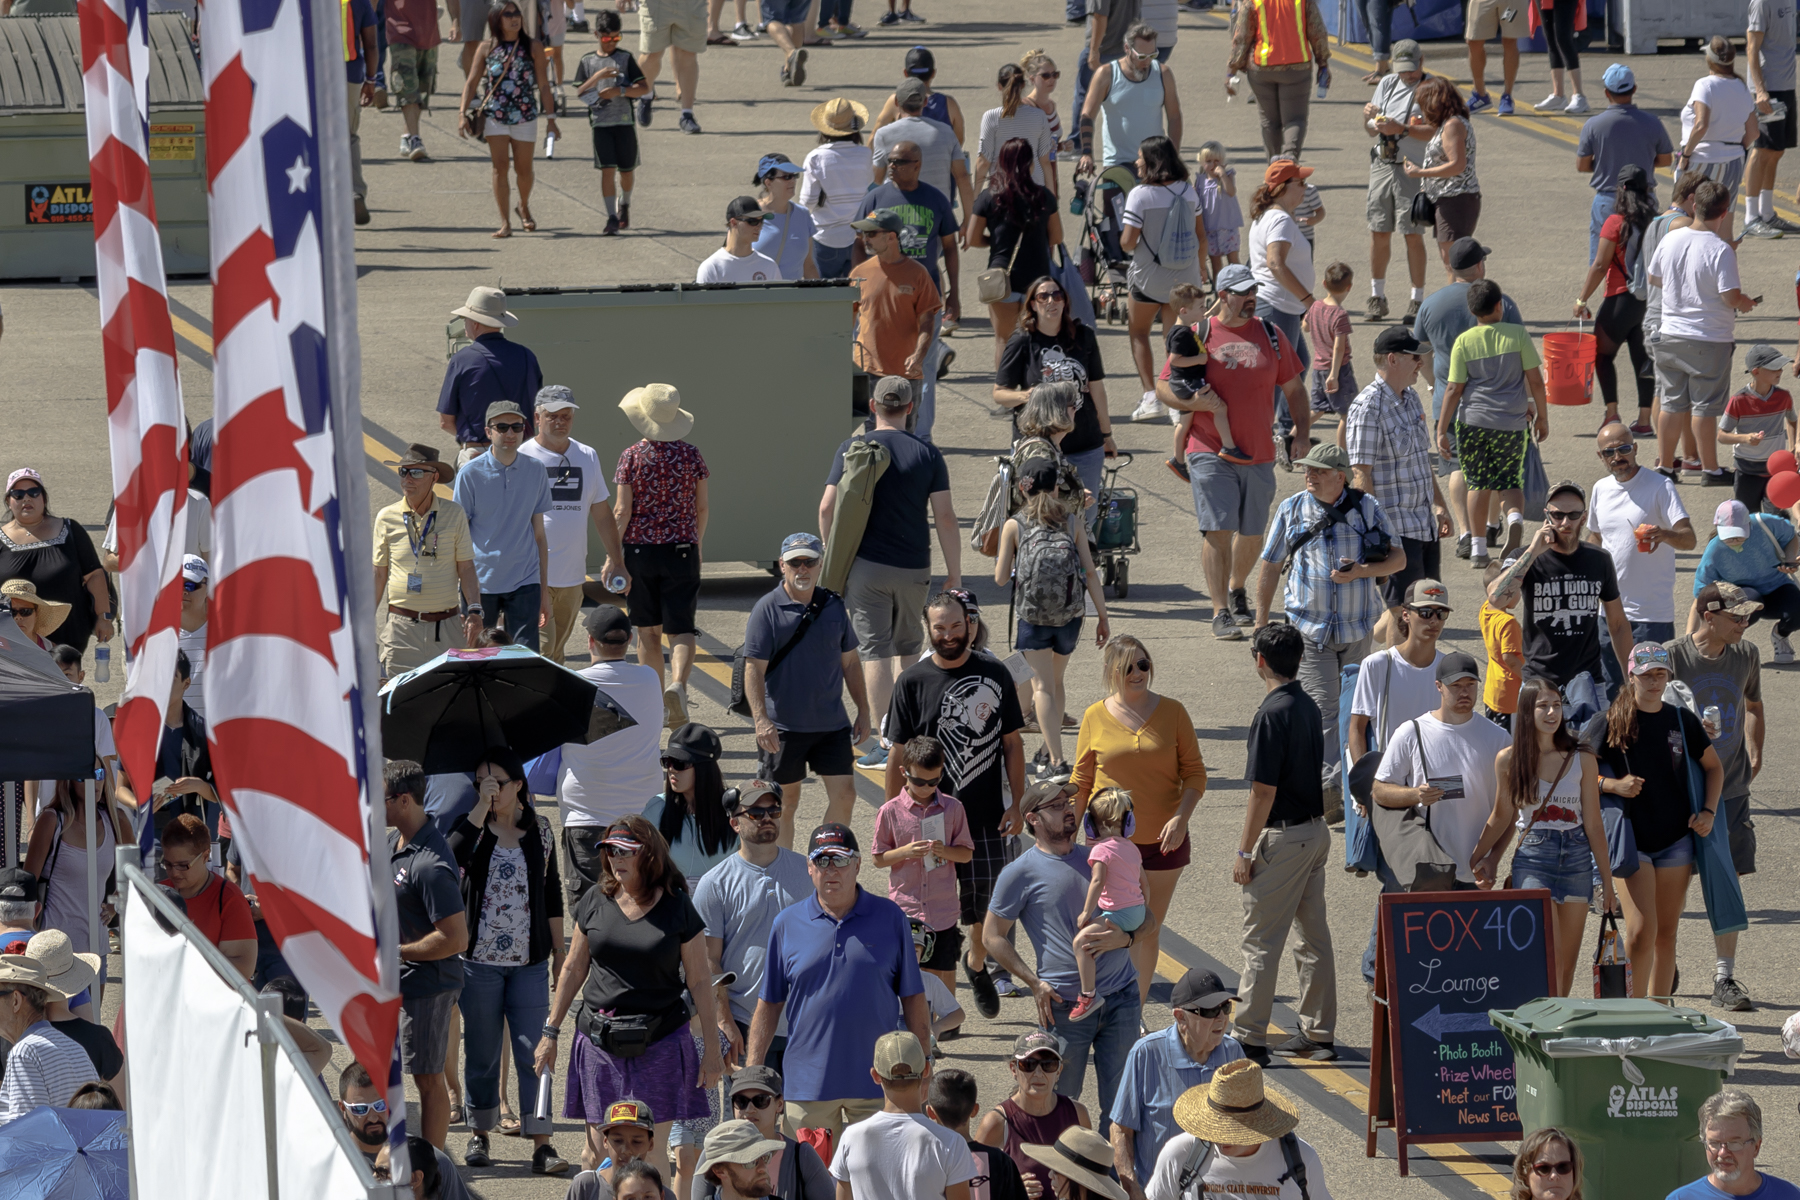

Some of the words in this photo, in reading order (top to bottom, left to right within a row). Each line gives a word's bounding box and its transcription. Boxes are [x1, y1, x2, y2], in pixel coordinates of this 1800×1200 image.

[51, 185, 93, 204] ATL
[51, 203, 94, 215] DISPOS
[1534, 581, 1561, 597] BAN
[1563, 580, 1602, 595] IDIOTS
[1533, 596, 1563, 611] NOT
[1568, 595, 1600, 610] GUNS
[1404, 909, 1482, 953] FOX
[1484, 904, 1536, 951] 40
[1408, 958, 1500, 1004] Lounge
[1439, 1043, 1468, 1061] Photo
[1471, 1041, 1503, 1058] Booth
[1440, 1066, 1470, 1082] Prize
[1471, 1063, 1516, 1080] Wheel
[1441, 1087, 1470, 1104] Meet
[1473, 1092, 1490, 1103] our
[1493, 1085, 1517, 1101] FOX
[1626, 1084, 1678, 1101] ATLAS
[1458, 1109, 1490, 1125] News
[1491, 1105, 1520, 1122] Tea
[1626, 1101, 1678, 1110] DISPOSAL
[1226, 1184, 1245, 1194] STATE
[1246, 1184, 1280, 1196] UNIVERSITY
